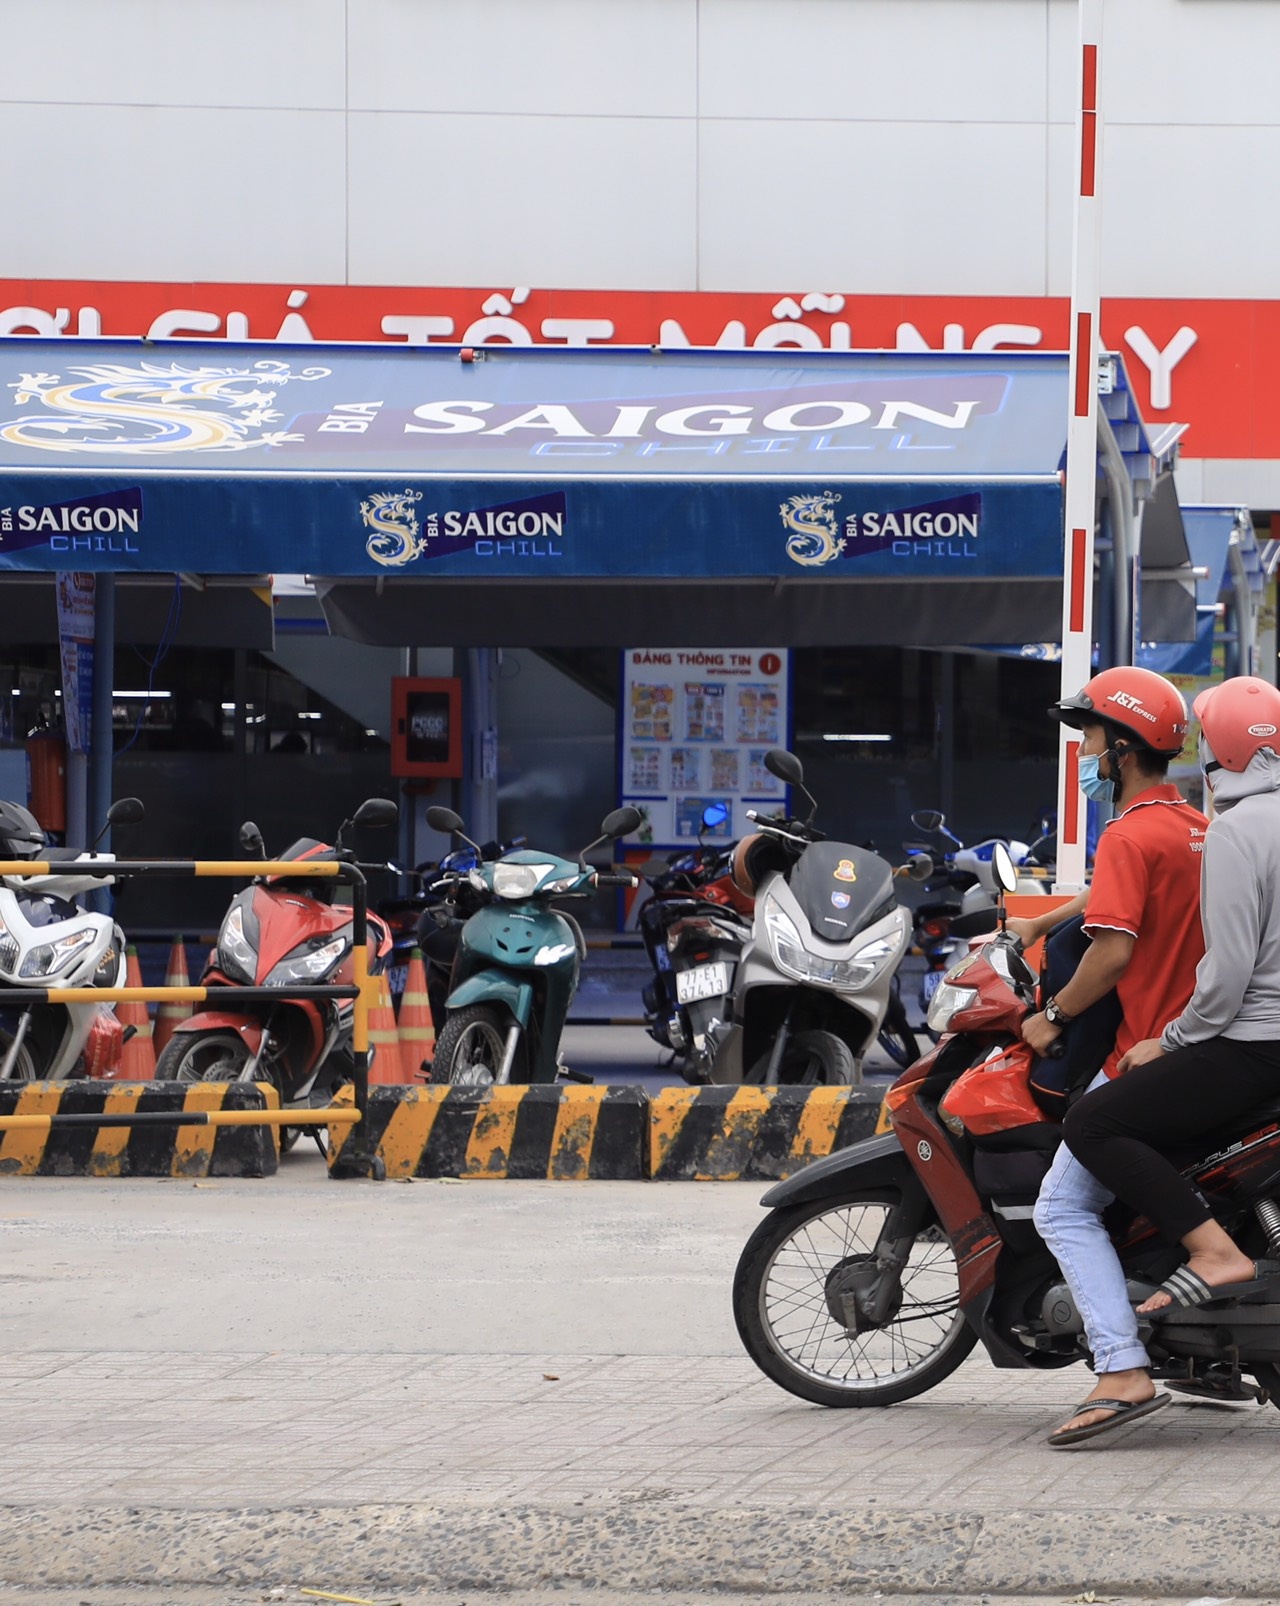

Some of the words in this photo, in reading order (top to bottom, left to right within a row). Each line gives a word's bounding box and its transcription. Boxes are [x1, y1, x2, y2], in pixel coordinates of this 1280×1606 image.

[318, 401, 384, 434] BIA
[403, 400, 981, 437] SAIGON
[530, 434, 956, 457] CHILL
[1, 507, 13, 531] BIA
[17, 505, 139, 532] SAIGON
[427, 512, 439, 537] BIA
[443, 511, 563, 537] SAIGON
[846, 513, 858, 537] BIA
[862, 512, 978, 538] SAIGON
[50, 535, 139, 552] CHILL
[475, 540, 563, 556] CHILL
[892, 541, 977, 557] CHILL
[632, 651, 672, 665] BẢNG
[677, 653, 724, 666] THÔNG
[729, 655, 751, 666] TIN
[1107, 690, 1144, 710] J&T
[1132, 706, 1158, 724] EXPRESS
[684, 966, 718, 985] 77-E1
[681, 979, 724, 1001] 374.13
